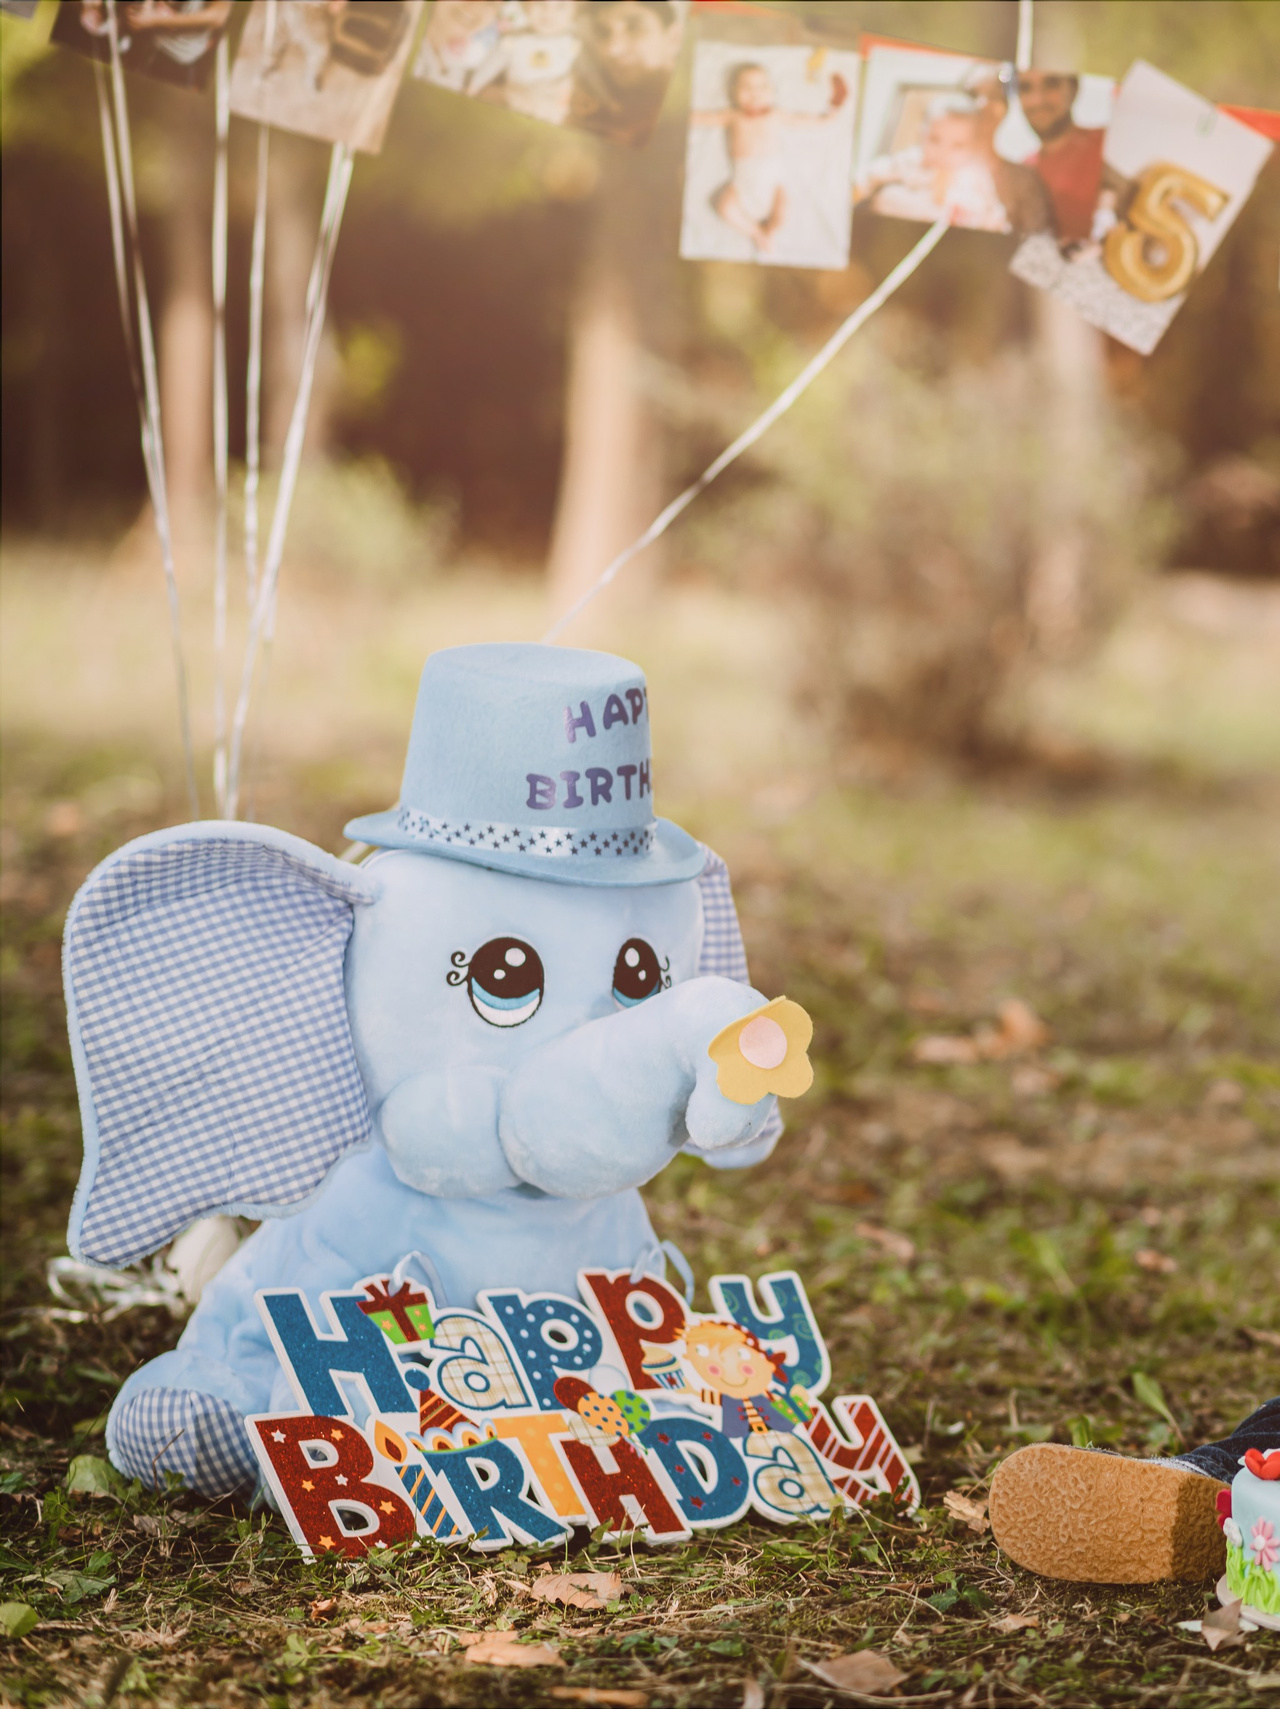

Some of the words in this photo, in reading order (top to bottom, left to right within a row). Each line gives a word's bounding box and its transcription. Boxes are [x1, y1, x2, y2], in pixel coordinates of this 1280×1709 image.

[562, 687, 649, 743] HAP
[526, 758, 650, 810] BIRTH
[257, 1271, 828, 1417] Happy
